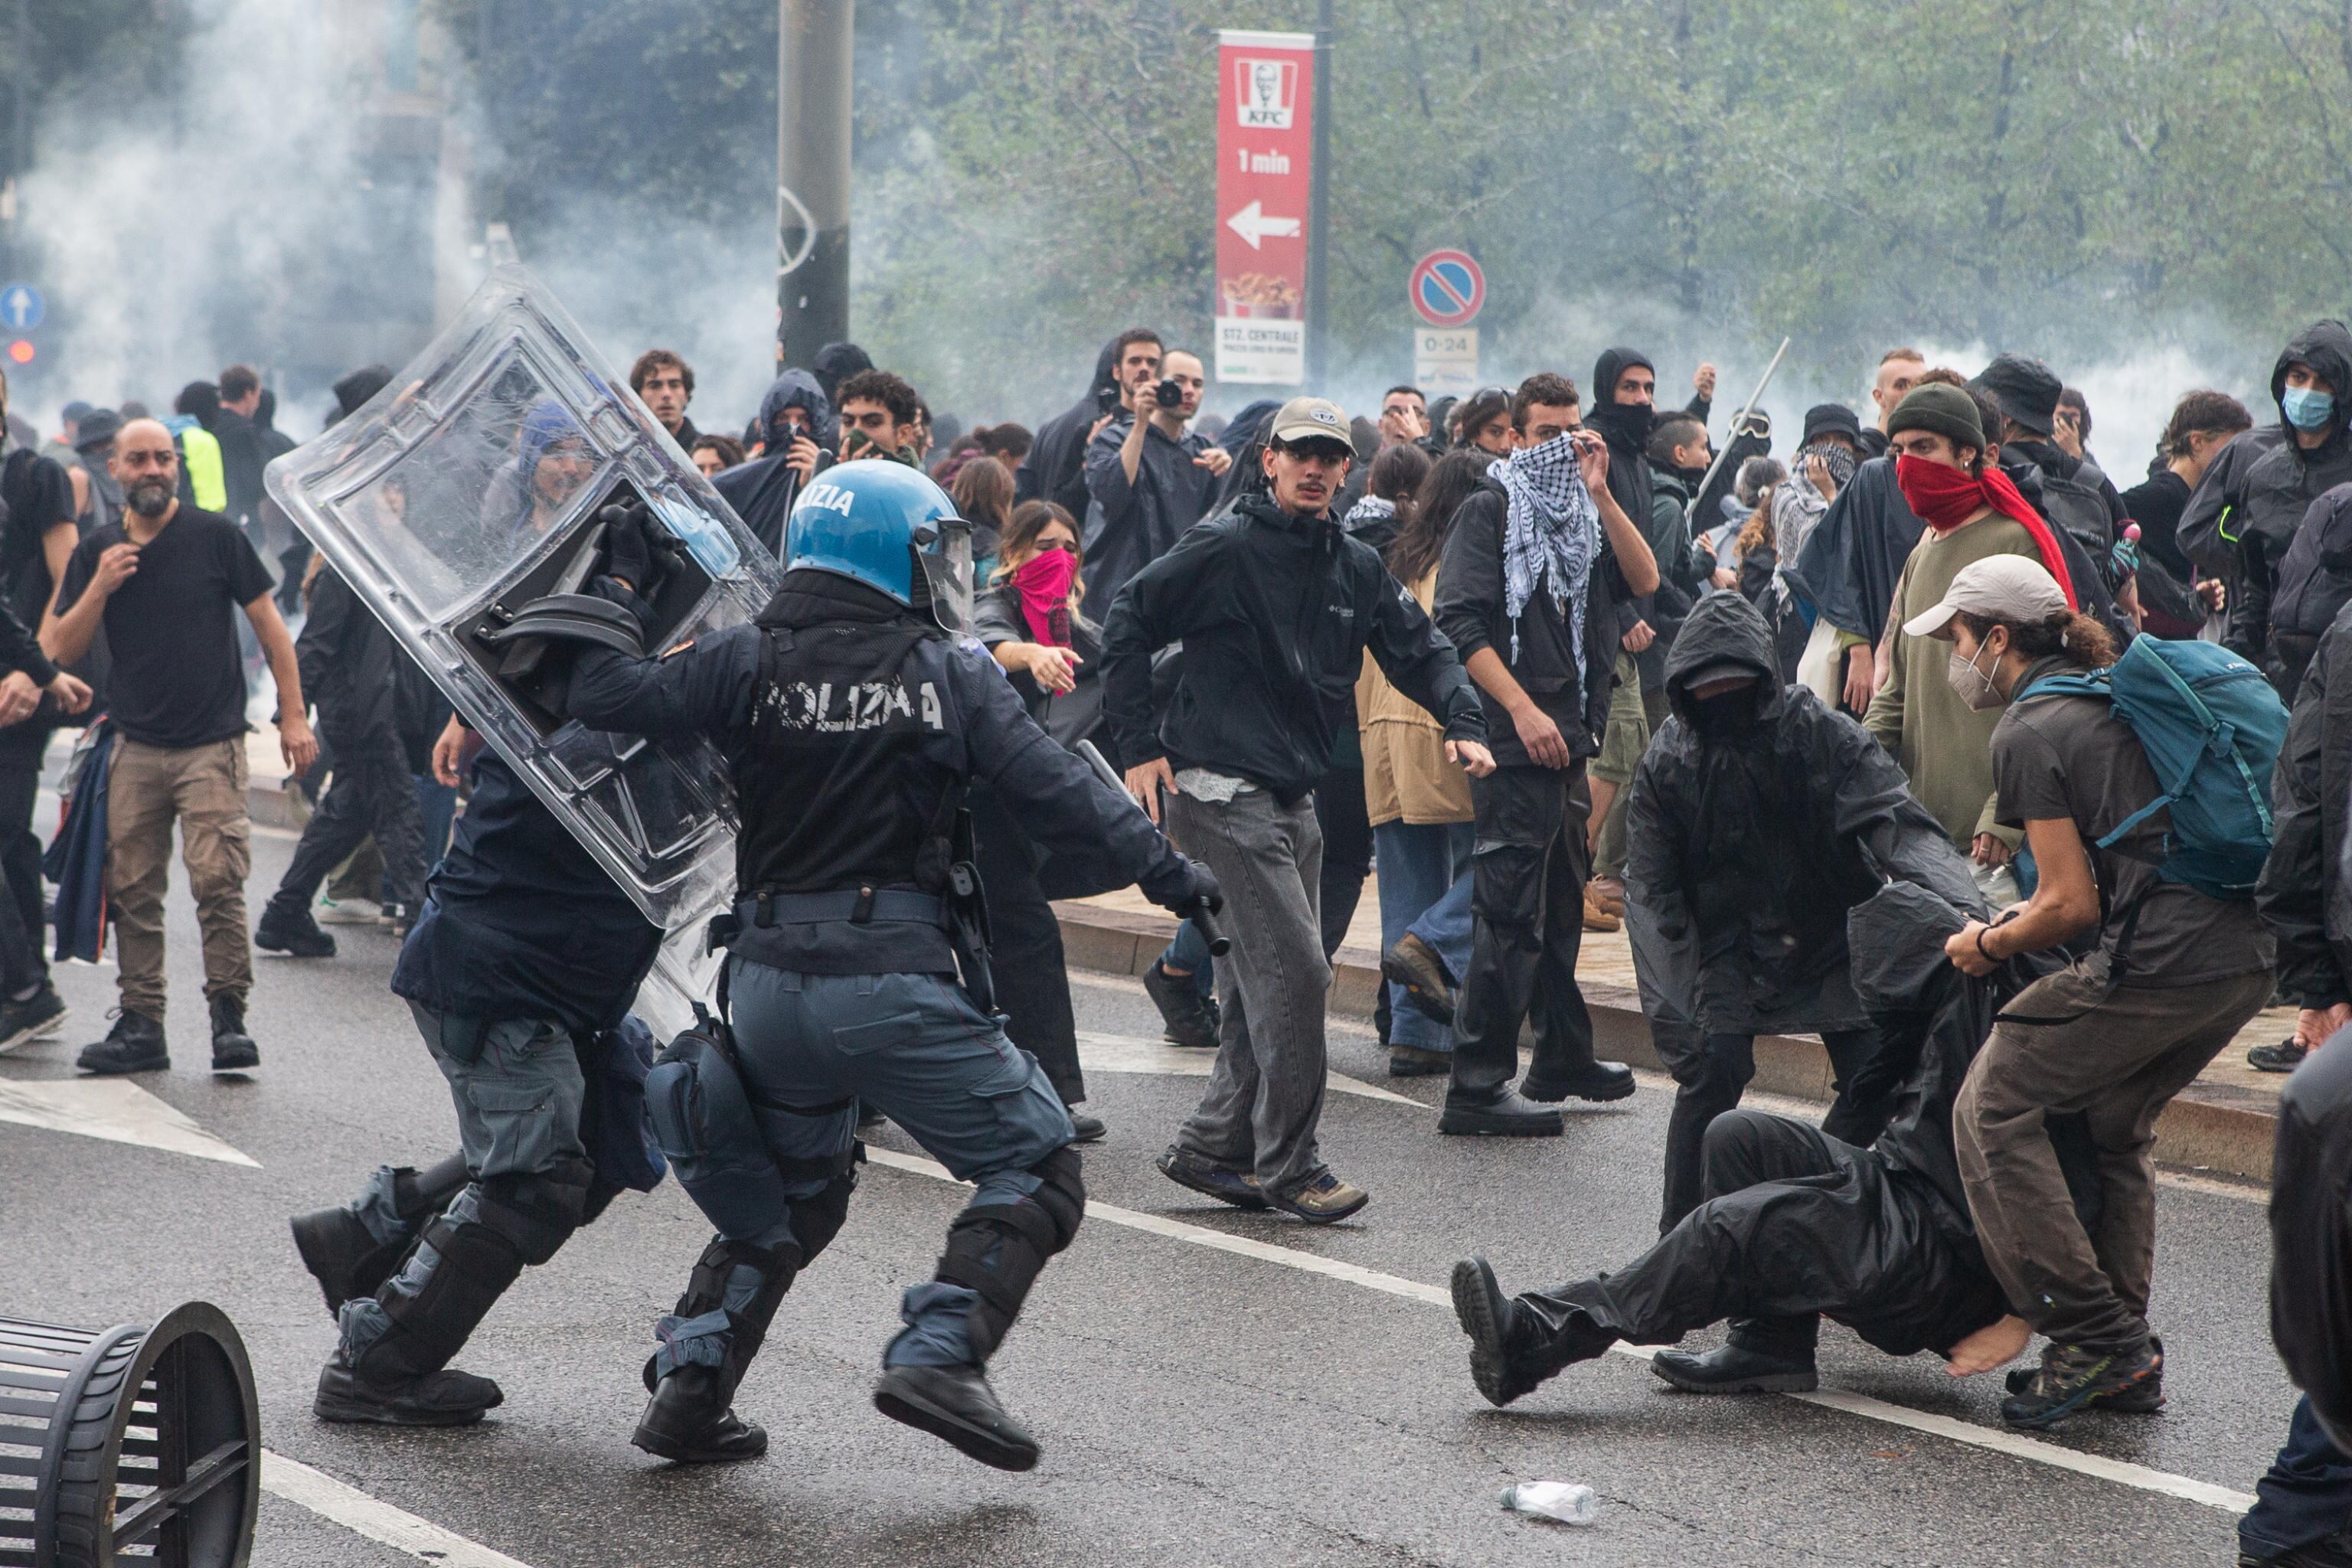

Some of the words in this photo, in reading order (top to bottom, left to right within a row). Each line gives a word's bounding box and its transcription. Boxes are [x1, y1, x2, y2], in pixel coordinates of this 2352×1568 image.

[1248, 110, 1283, 124] KFC
[1238, 149, 1249, 173] 1
[1251, 149, 1290, 175] min
[1249, 329, 1298, 343] CENTRALE
[1424, 338, 1467, 352] 0-24
